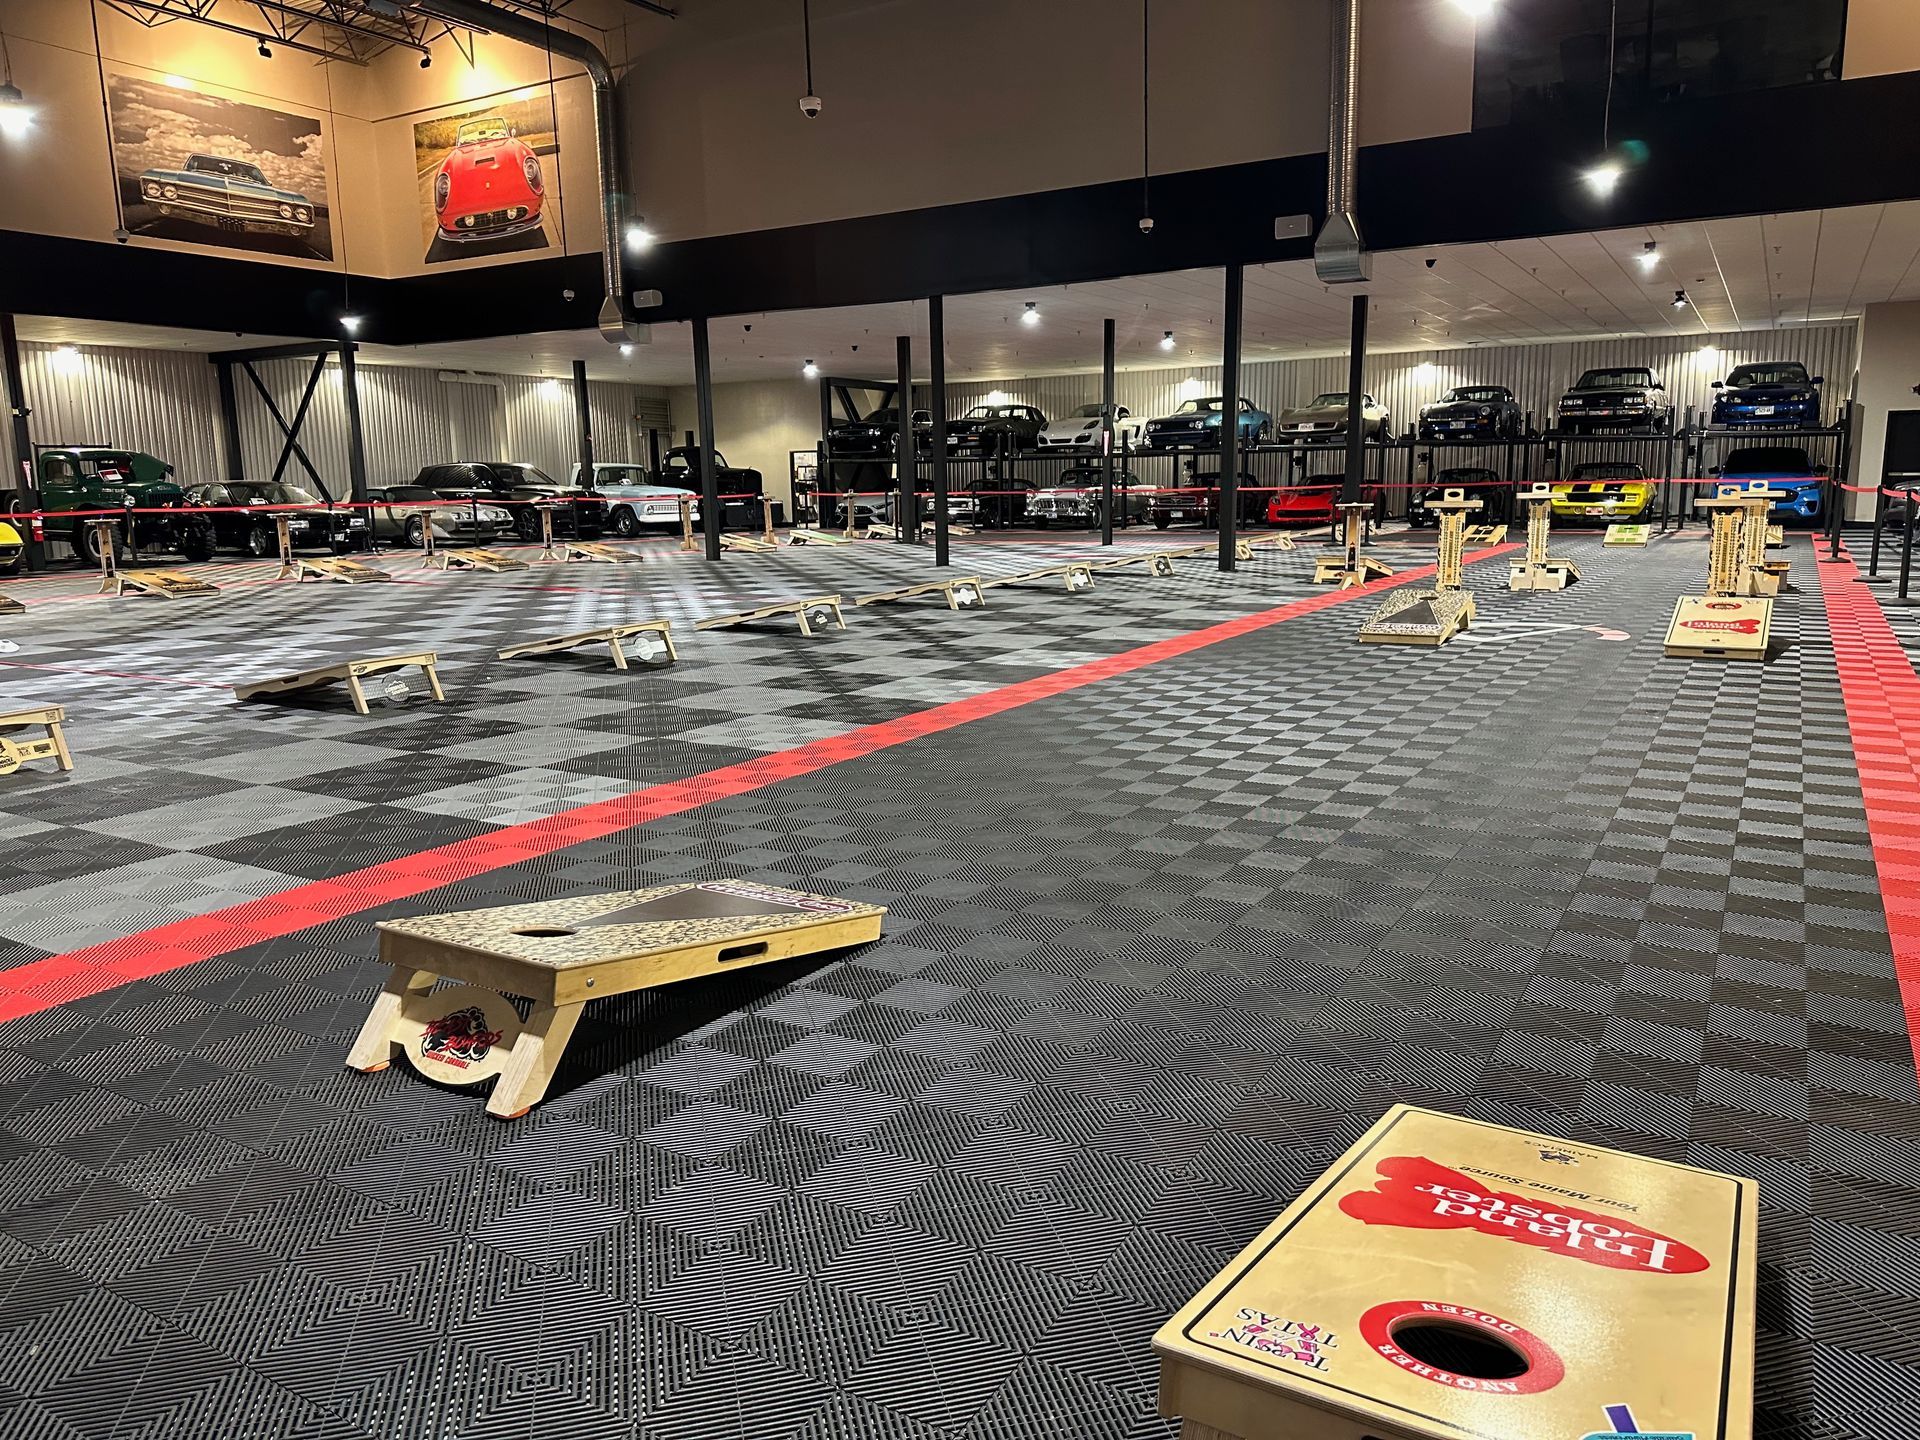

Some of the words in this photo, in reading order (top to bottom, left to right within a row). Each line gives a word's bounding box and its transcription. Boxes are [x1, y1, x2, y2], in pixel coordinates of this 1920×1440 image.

[1459, 1165, 1524, 1184] Source
[1528, 1181, 1592, 1200] Maine
[1414, 1182, 1676, 1252] Lobster
[1597, 1197, 1639, 1213] Your
[1433, 1198, 1675, 1272] Inland
[1421, 1302, 1520, 1334] DOZEN
[1378, 1343, 1518, 1393] ANOTHER
